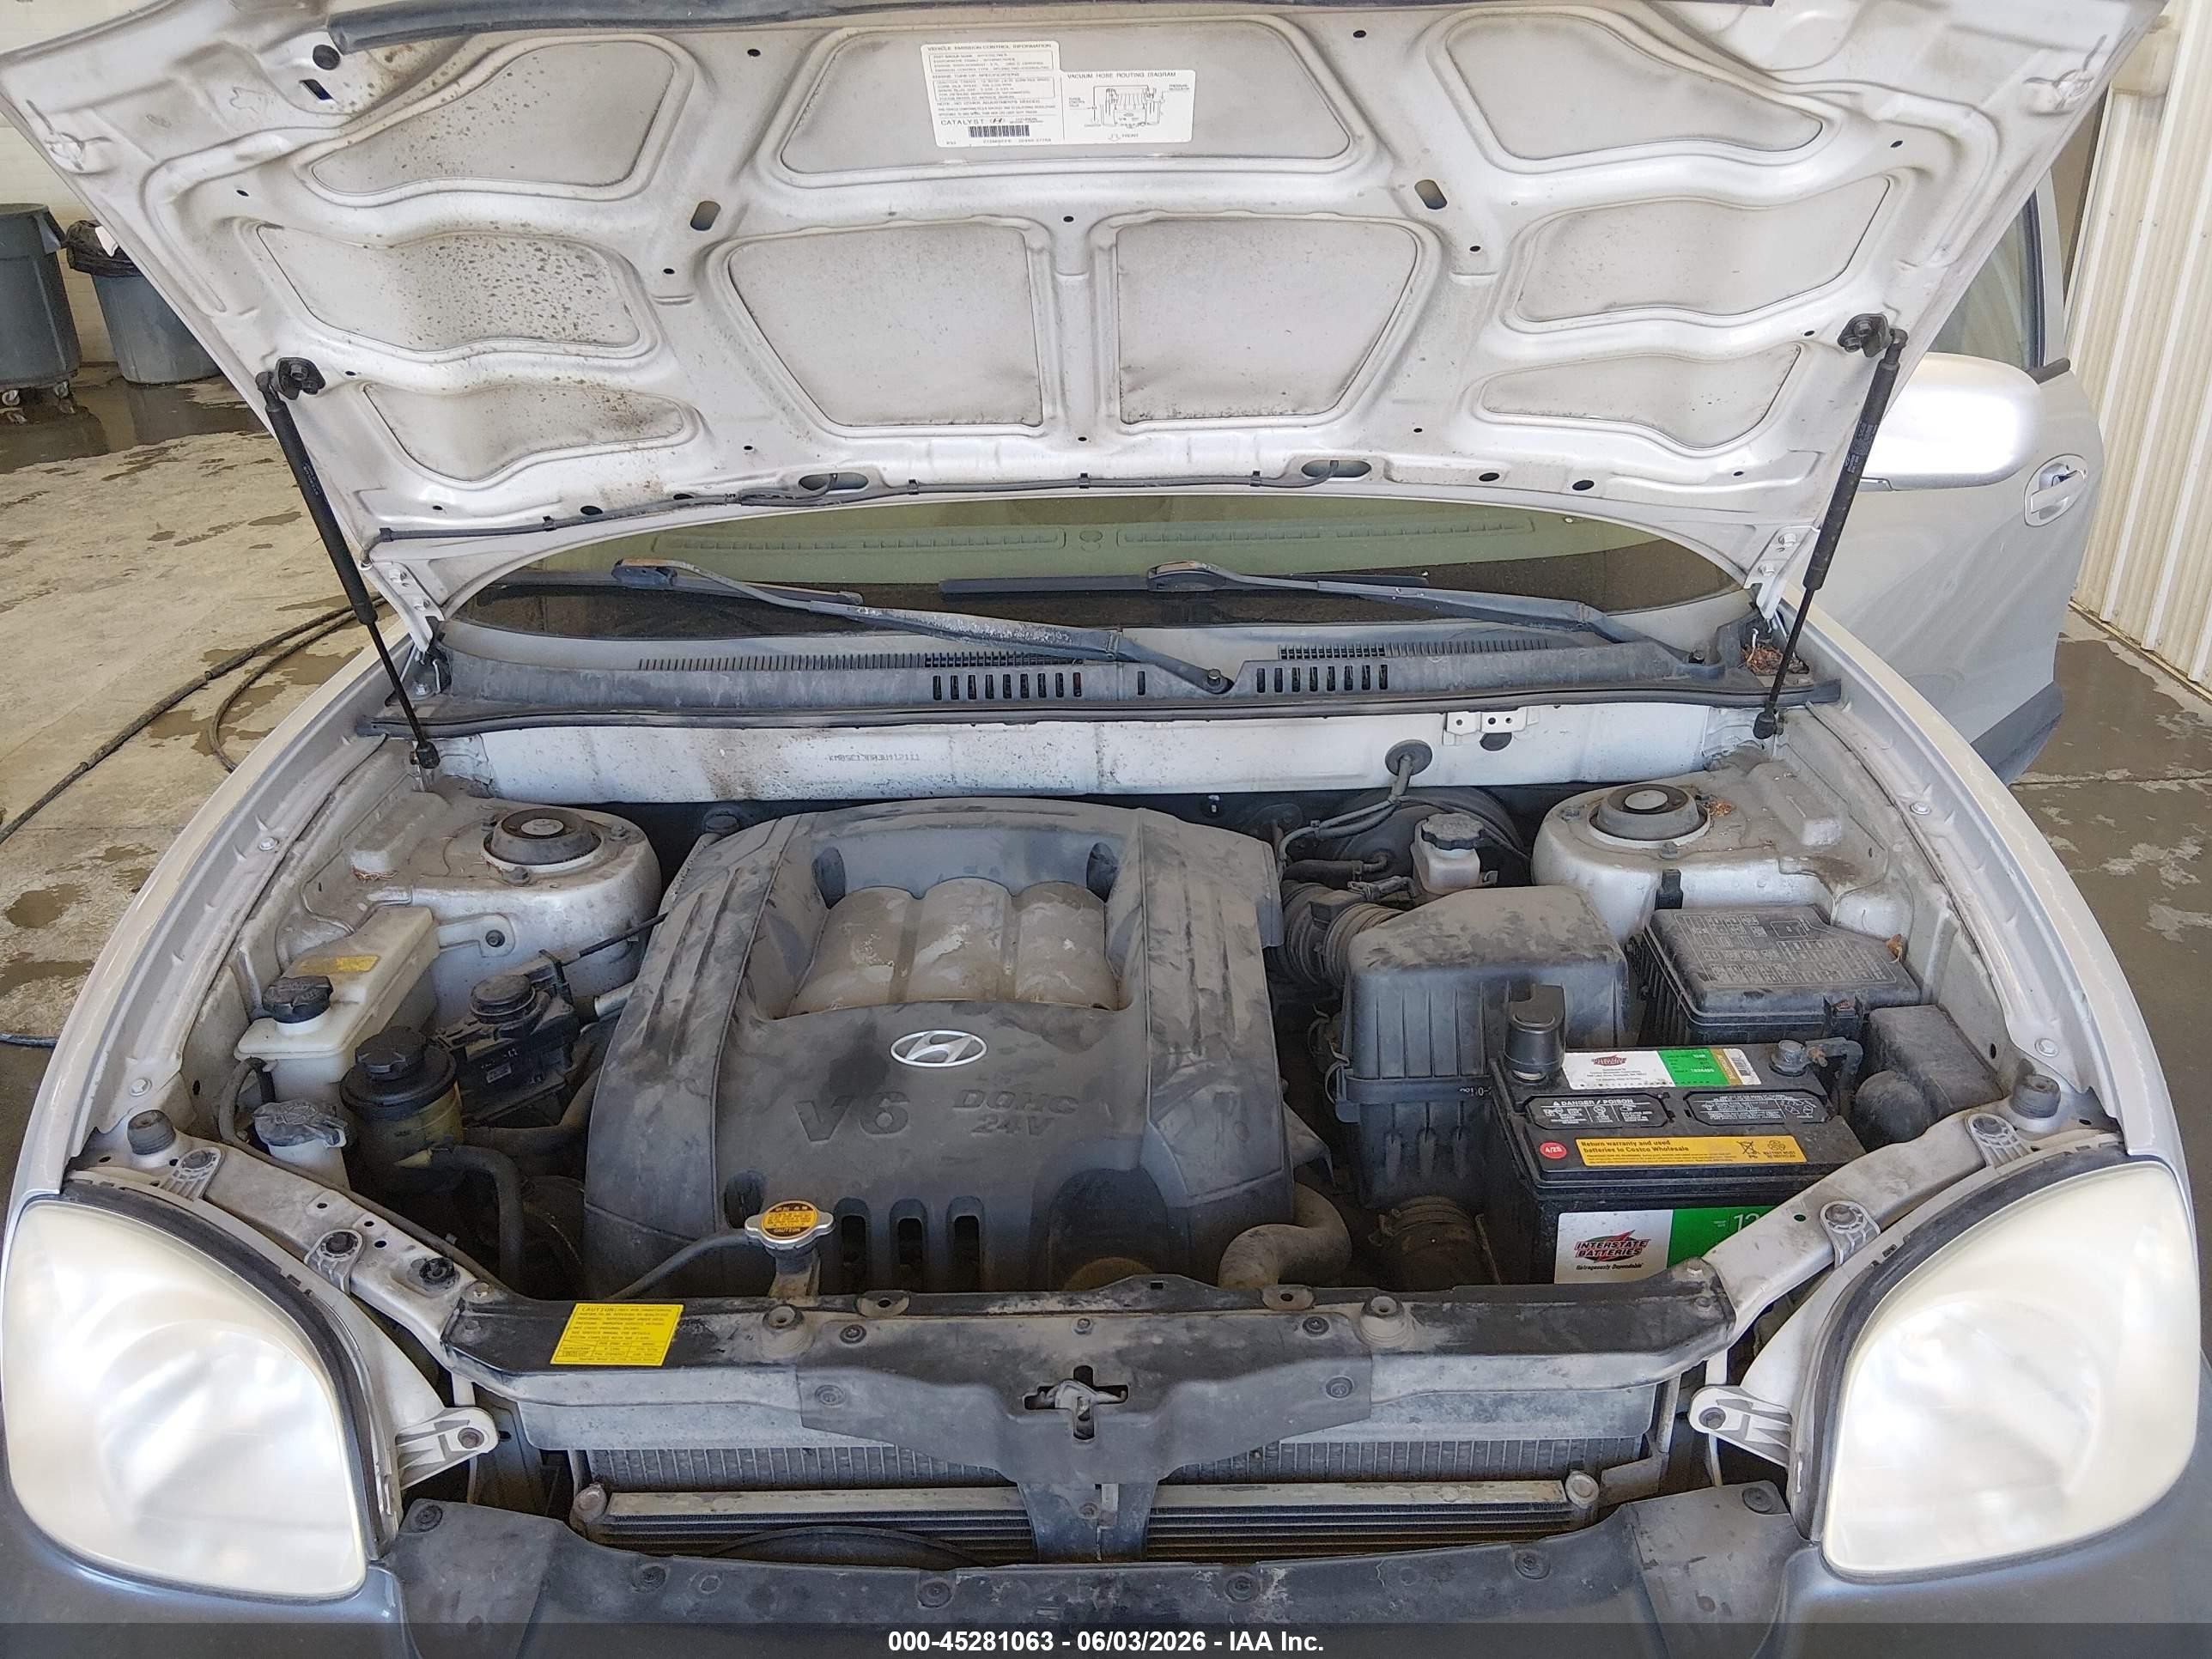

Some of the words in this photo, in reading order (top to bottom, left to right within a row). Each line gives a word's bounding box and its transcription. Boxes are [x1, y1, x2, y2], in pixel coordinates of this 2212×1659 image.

[953, 1089, 1080, 1115] DOHC
[793, 1091, 911, 1145] V6
[970, 1115, 1056, 1137] 24V
[1576, 1239, 1649, 1250] INTERSTATE
[1577, 1248, 1643, 1258] BATTERIES
